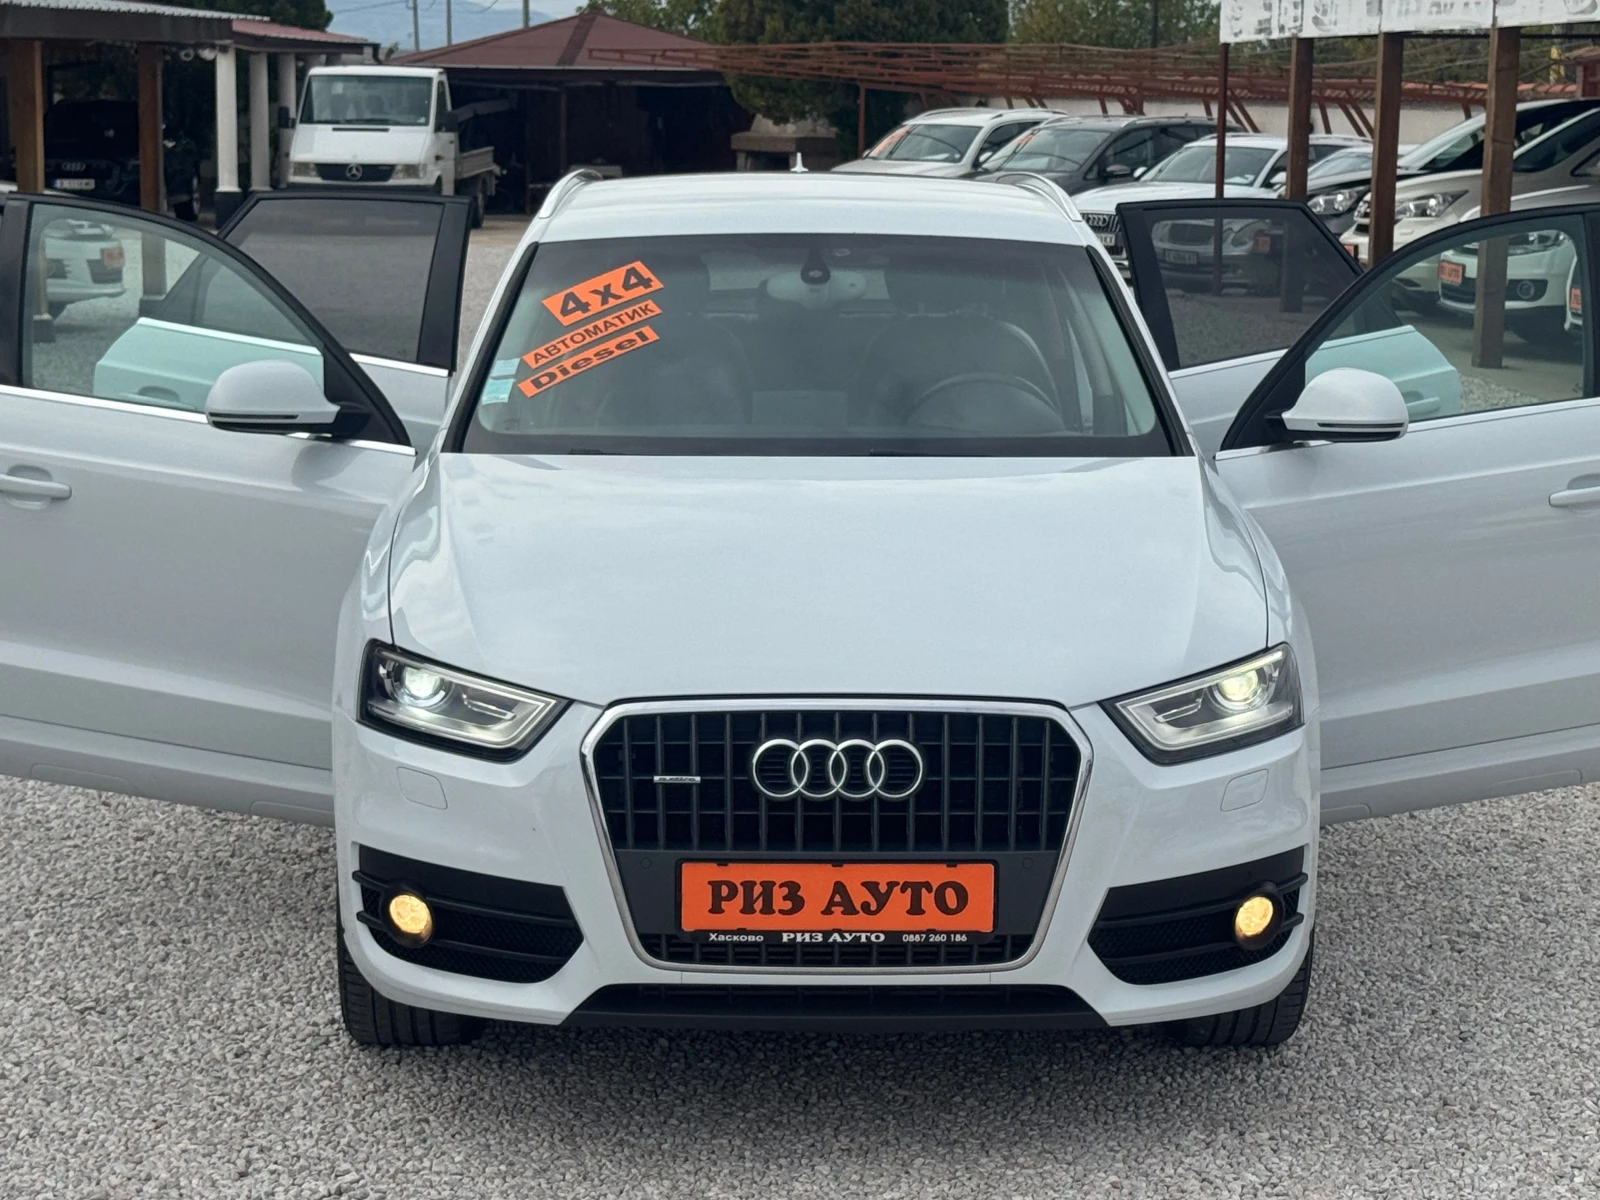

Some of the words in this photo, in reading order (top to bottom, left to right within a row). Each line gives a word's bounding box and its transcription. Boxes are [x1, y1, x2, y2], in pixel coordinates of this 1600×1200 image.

[533, 303, 655, 365] АВТОМАТИК
[530, 330, 650, 390] Diesel
[708, 880, 805, 915] РИЗ
[820, 880, 969, 915] АУТО
[708, 932, 764, 942] Хасково
[781, 932, 823, 943] РИЗ
[827, 932, 886, 943] АУТО
[902, 933, 926, 942] 0887
[929, 933, 947, 942] 260
[950, 933, 967, 942] 186
